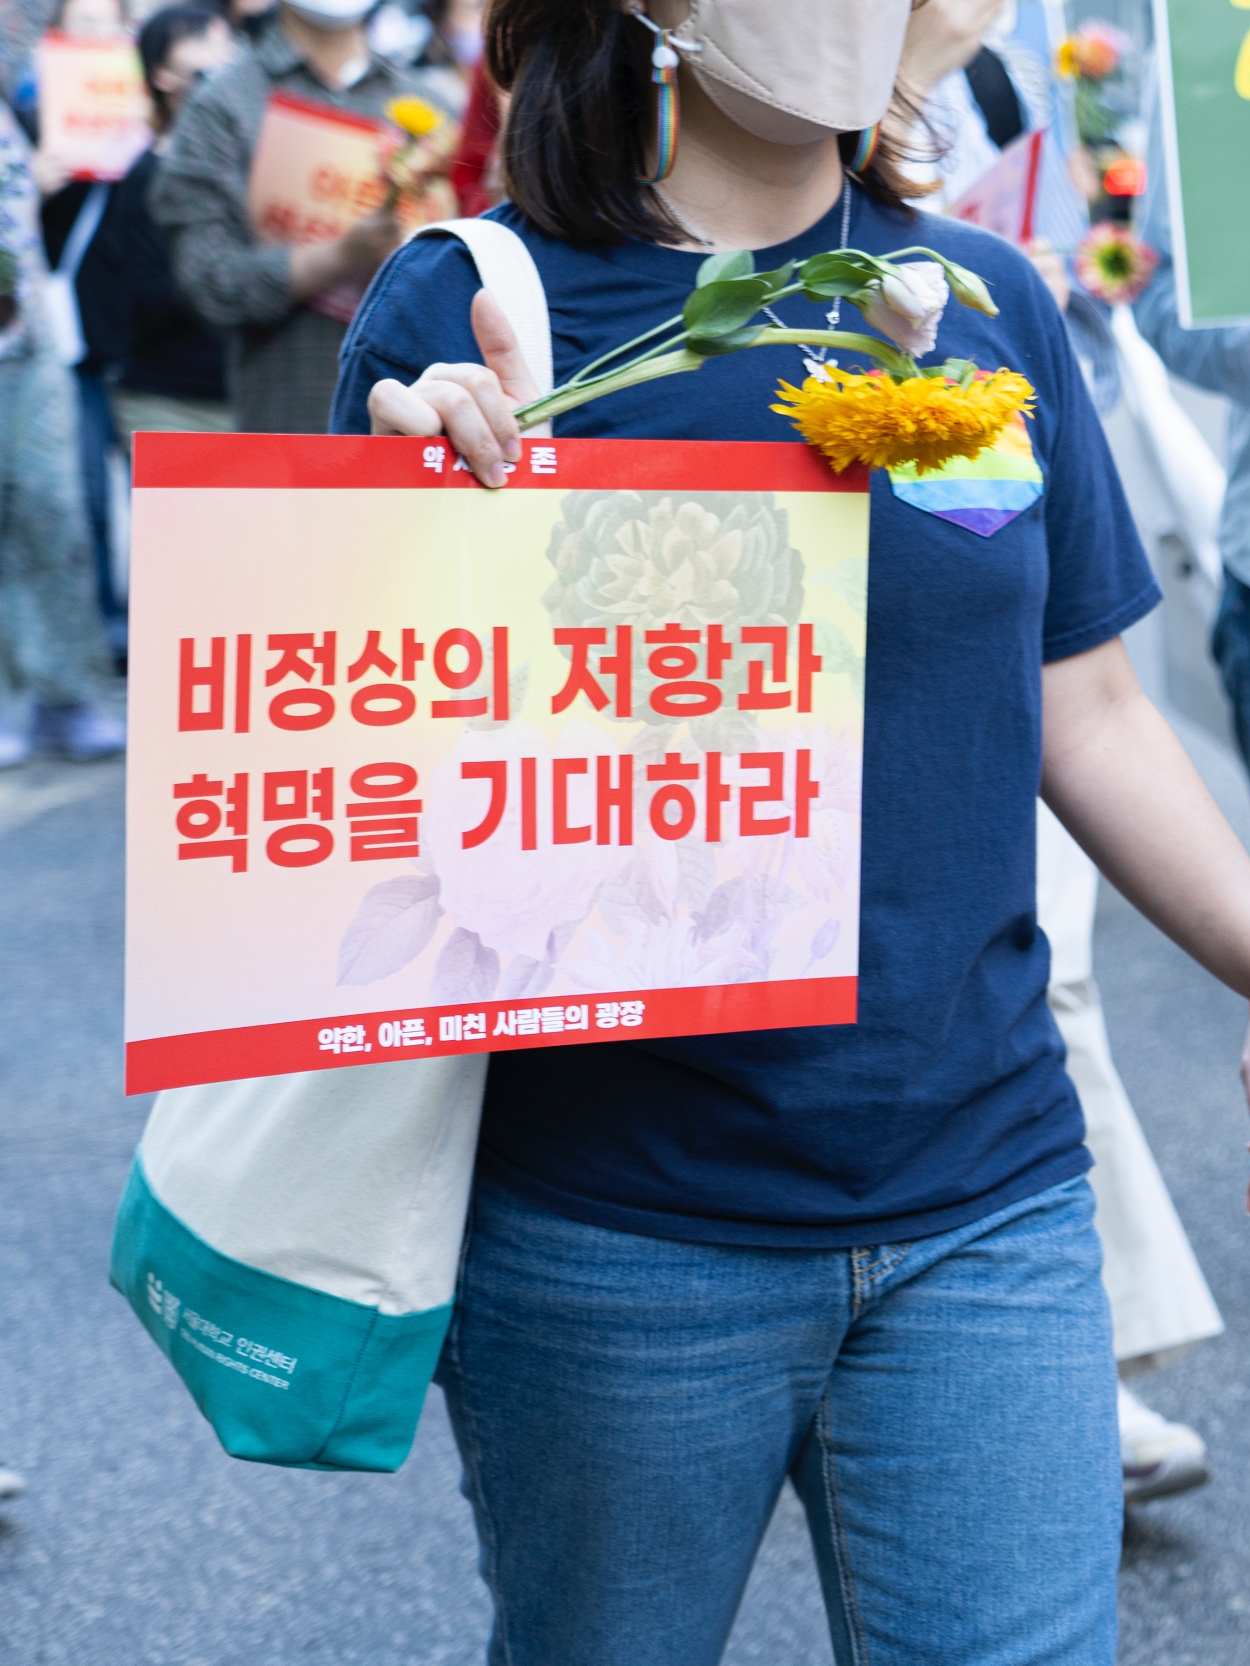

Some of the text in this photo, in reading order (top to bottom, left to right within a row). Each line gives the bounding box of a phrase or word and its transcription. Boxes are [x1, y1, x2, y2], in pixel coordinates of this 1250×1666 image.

[177, 622, 823, 734] 비정상의 저항과
[172, 748, 820, 874] 혁명을 기대하라
[318, 1000, 646, 1054] 약한, 아픈, 미친 사람들의 광장
